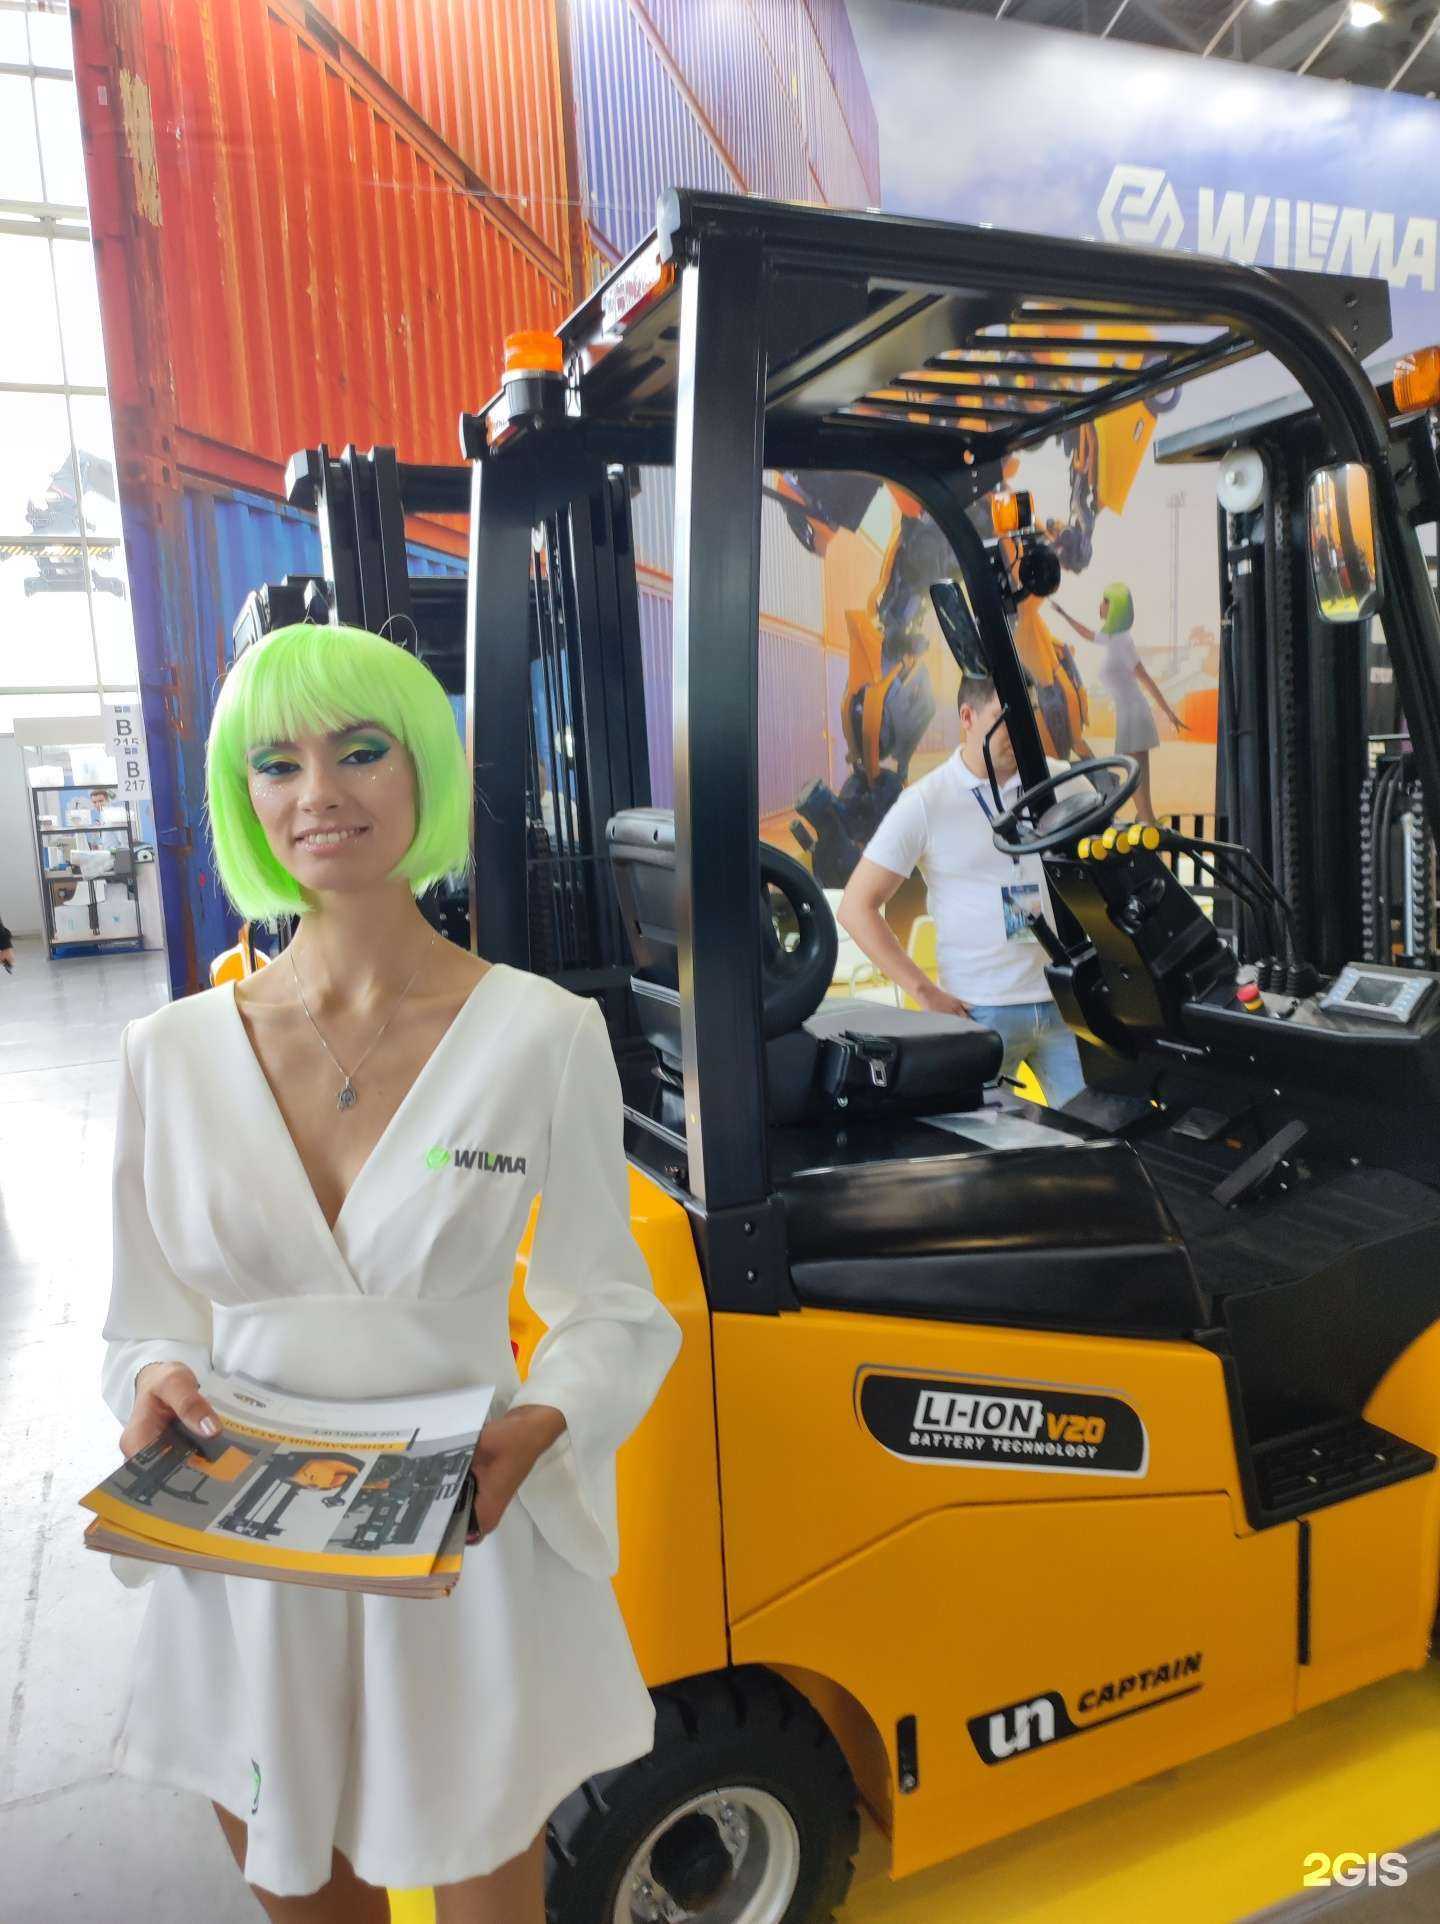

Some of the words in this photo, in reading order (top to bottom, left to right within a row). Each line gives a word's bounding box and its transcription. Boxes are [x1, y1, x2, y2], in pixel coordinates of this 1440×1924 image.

[1198, 187, 1439, 292] WILMA
[116, 719, 132, 736] B
[127, 761, 140, 778] B
[124, 780, 145, 792] 217
[454, 1149, 527, 1175] WILMA
[922, 1395, 1035, 1433] LI-ION
[1047, 1412, 1106, 1444] V20
[908, 1431, 986, 1451] BATTERY
[991, 1438, 1099, 1459] TECHNOLOGY
[1078, 1651, 1204, 1713] CAPTAIN
